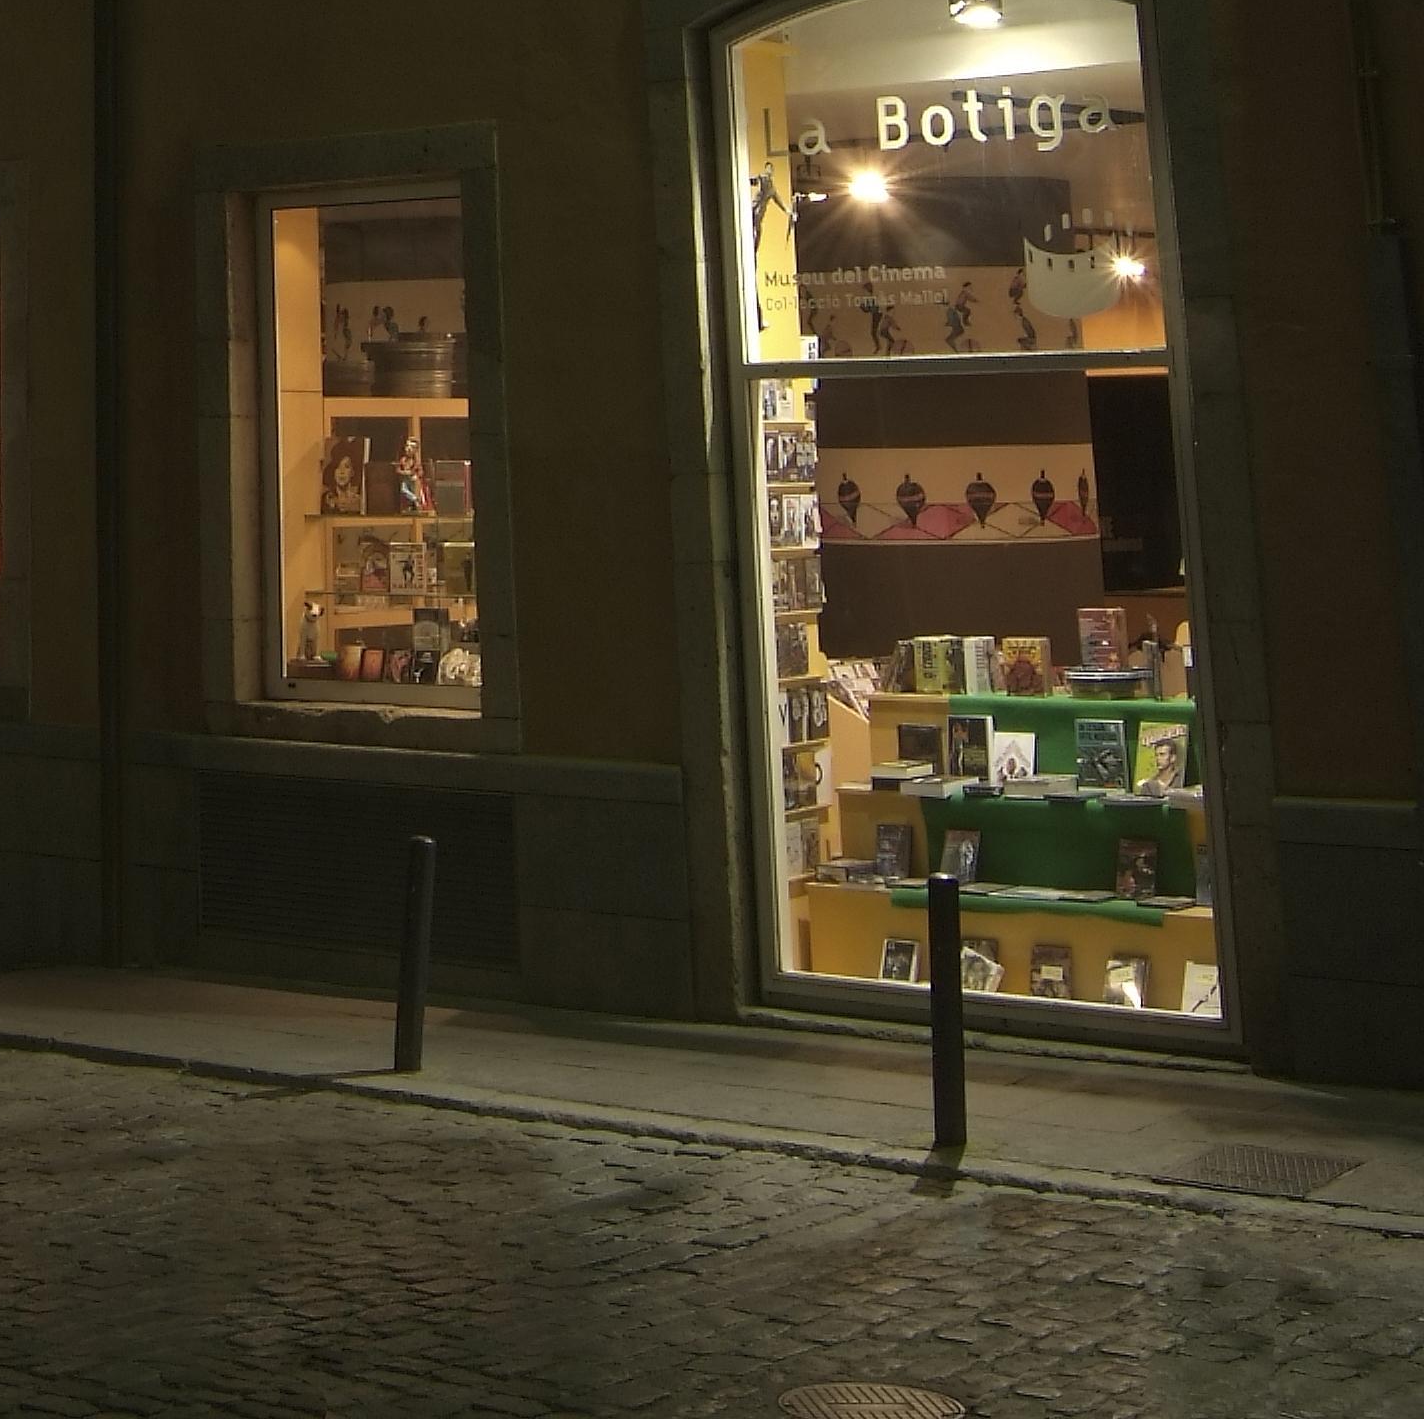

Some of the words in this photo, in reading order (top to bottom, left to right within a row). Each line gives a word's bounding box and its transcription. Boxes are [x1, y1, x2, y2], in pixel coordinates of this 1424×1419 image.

[763, 107, 832, 157] La
[875, 85, 1118, 153] Botiga
[764, 270, 825, 287] Museu
[831, 266, 862, 284] del
[868, 264, 947, 282] Cinema
